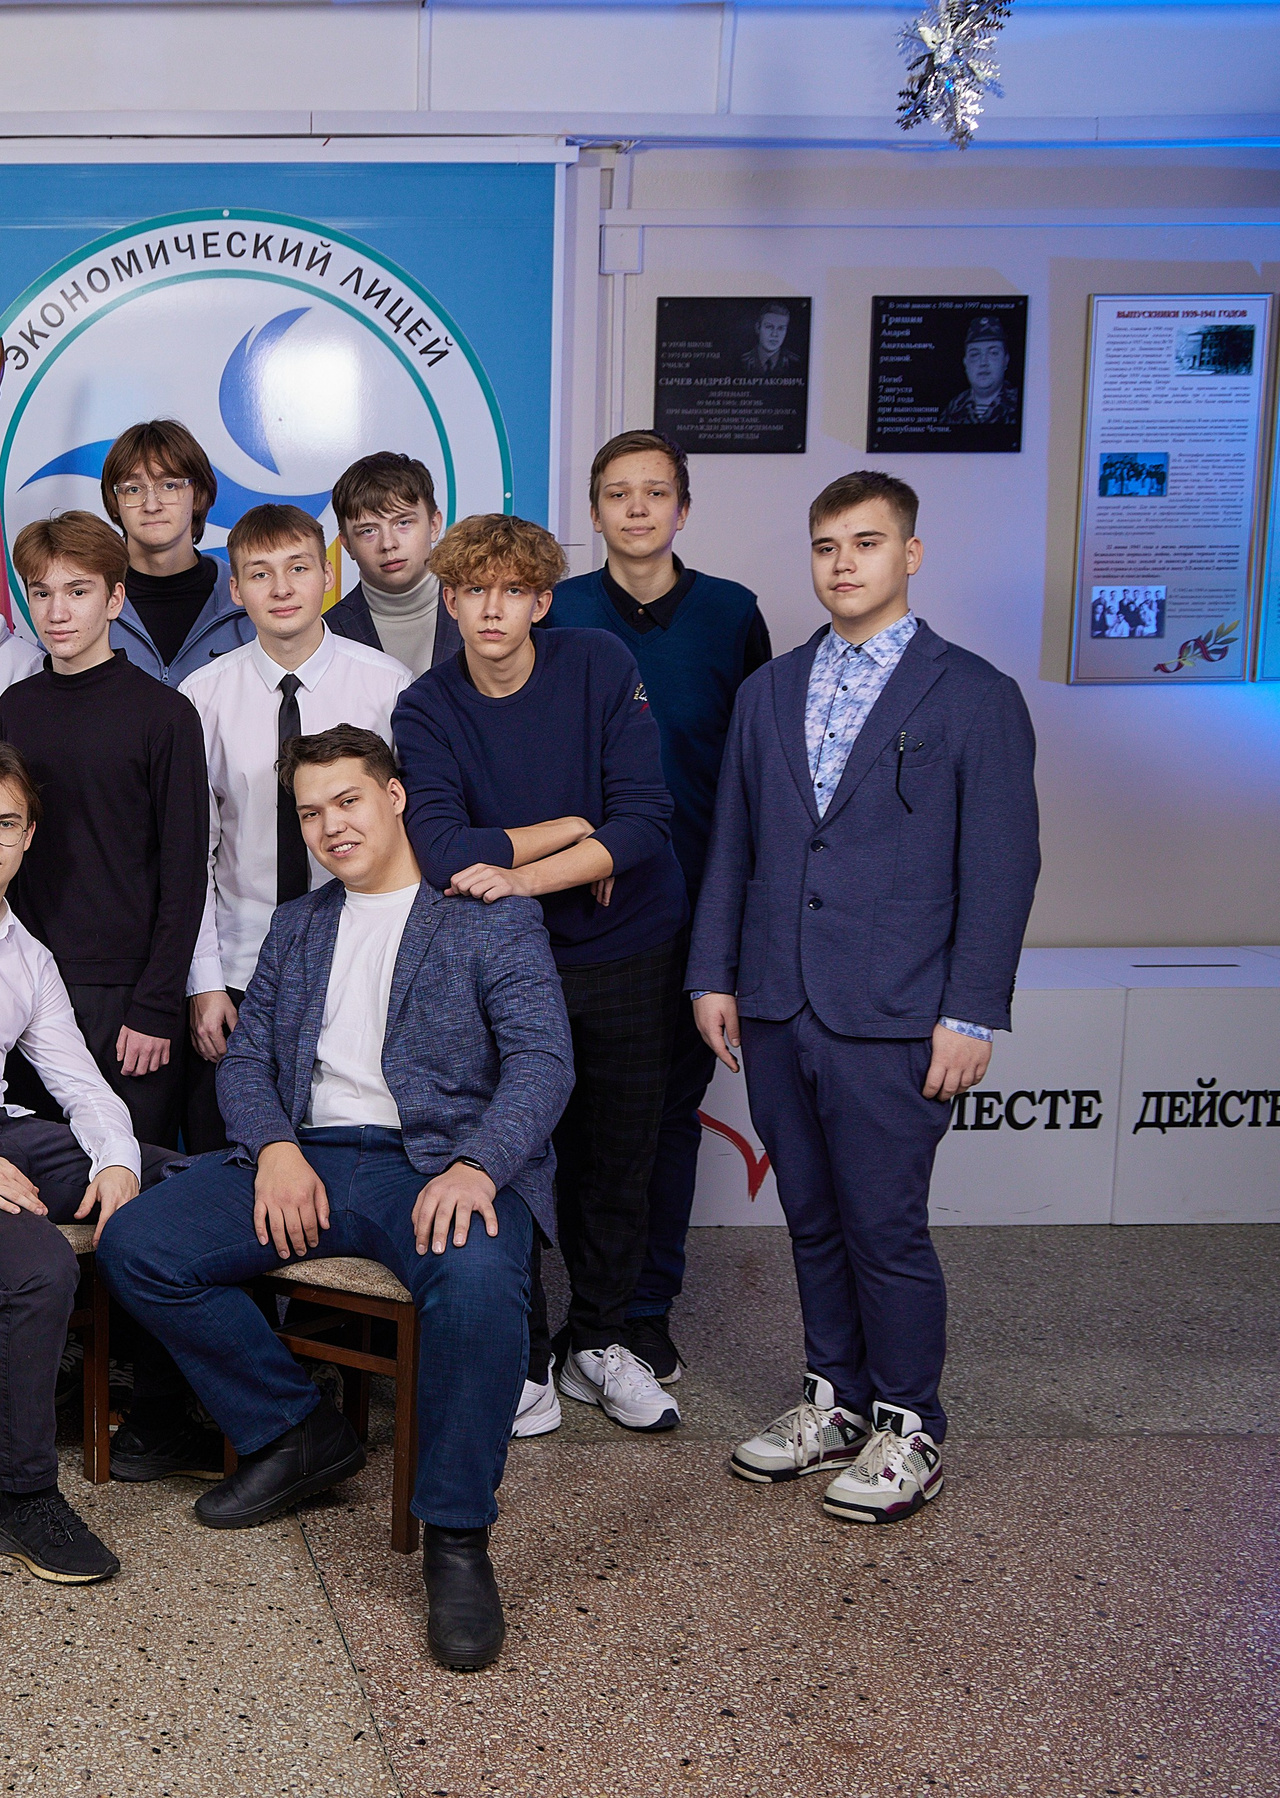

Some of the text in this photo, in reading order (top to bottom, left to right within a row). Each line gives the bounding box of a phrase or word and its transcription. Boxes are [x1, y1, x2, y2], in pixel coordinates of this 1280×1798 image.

[4, 231, 455, 370] ЭКОНОМИЧЕСКИЙ ЛИЦЕЙ
[964, 302, 980, 310] 1997
[1116, 310, 1180, 319] ВЫПУСКНИКИ
[1218, 310, 1248, 319] ГОДОВ
[881, 313, 923, 326] Гришин
[880, 328, 911, 338] Андрей
[658, 377, 692, 386] СЫЧЕВ
[694, 377, 731, 386] АНДРЕЙ
[878, 375, 903, 384] Погиб
[884, 385, 913, 394] августа
[897, 395, 914, 403] года
